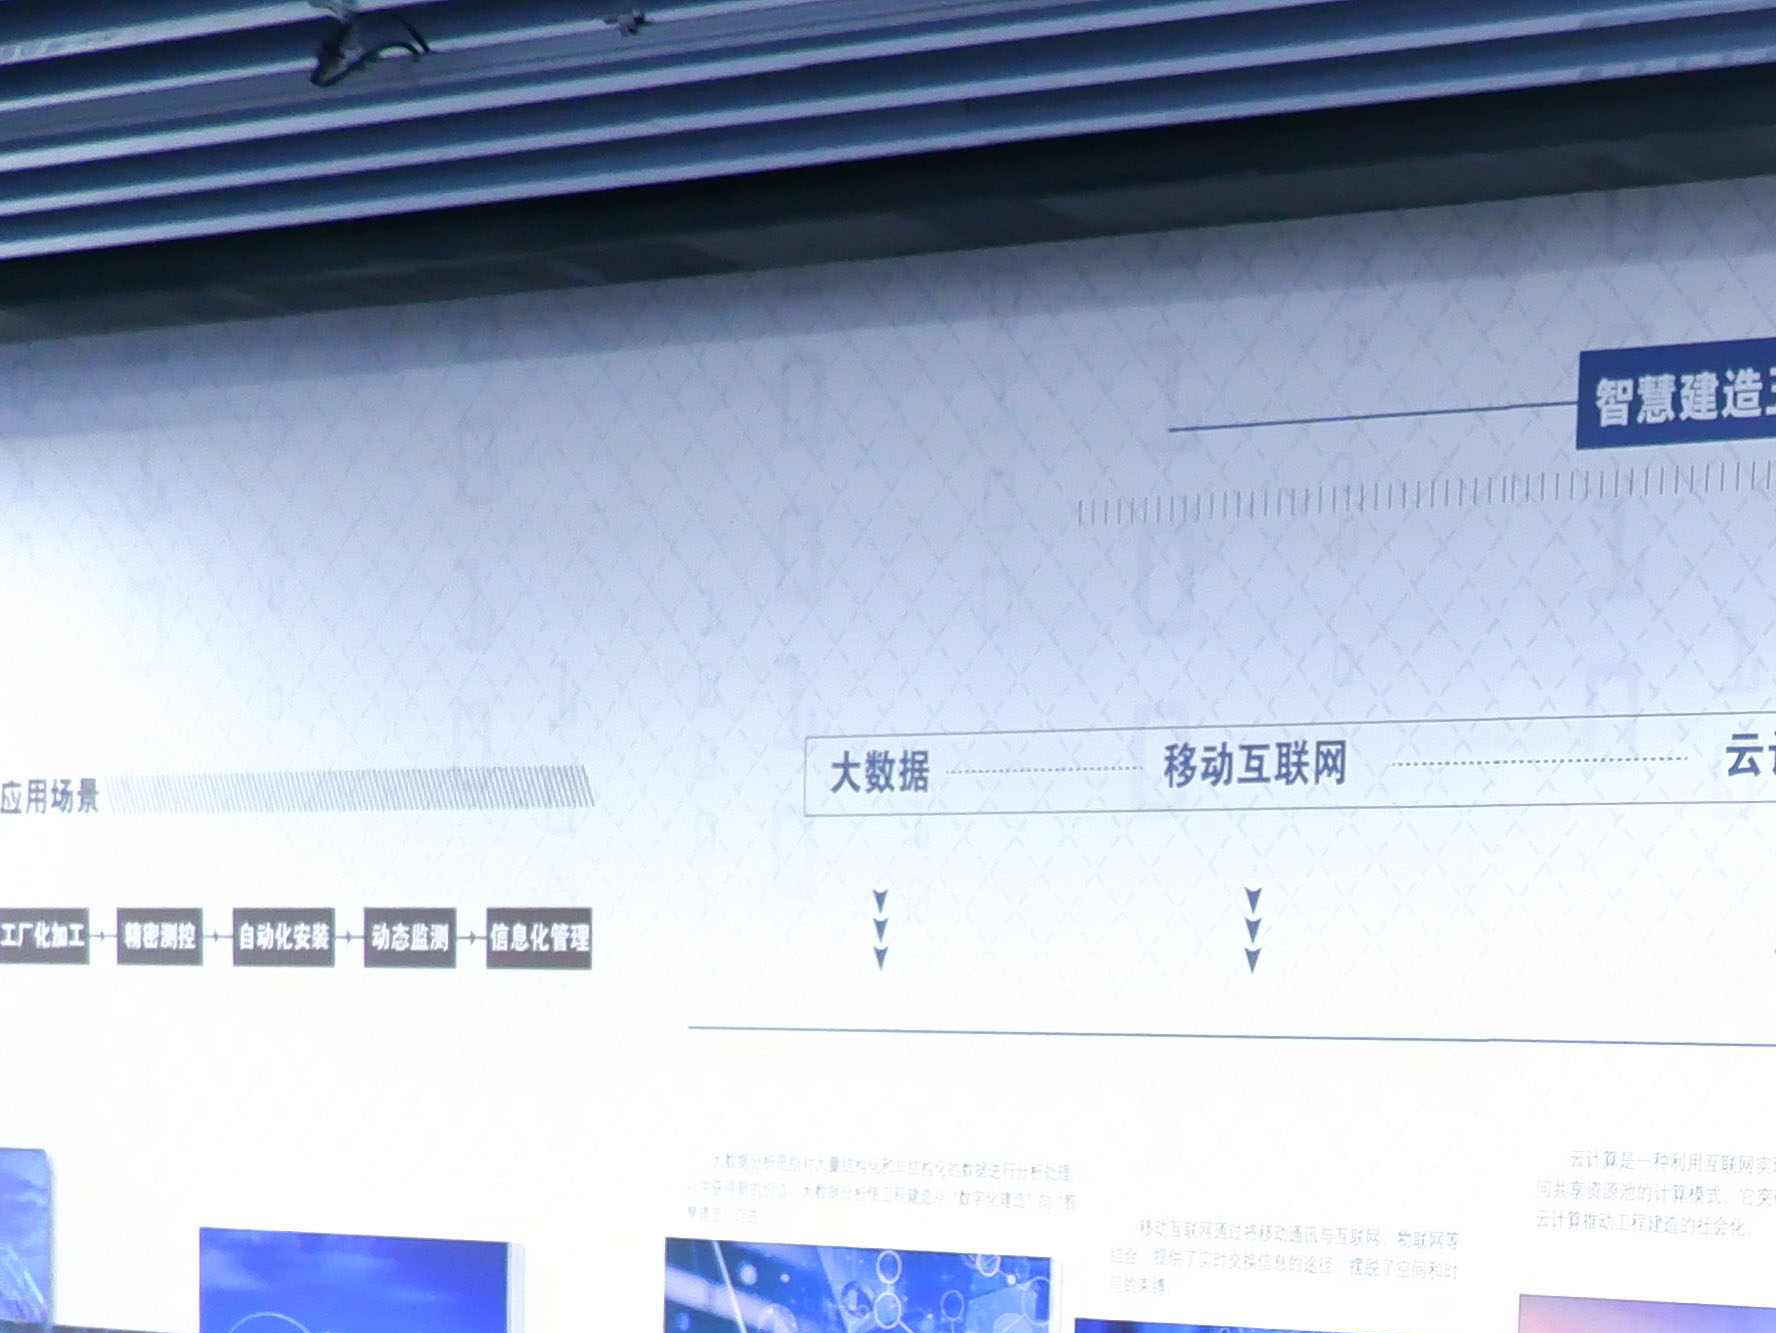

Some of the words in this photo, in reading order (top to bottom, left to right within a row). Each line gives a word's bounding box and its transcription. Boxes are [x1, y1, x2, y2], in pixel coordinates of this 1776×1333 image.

[829, 747, 931, 795] 大数据
[1162, 738, 1349, 790] 移动互联网
[1, 777, 99, 815] 应用场景
[239, 922, 330, 952] 自动化安装
[371, 922, 449, 952] 动态监测
[490, 921, 591, 953] 信息化管理
